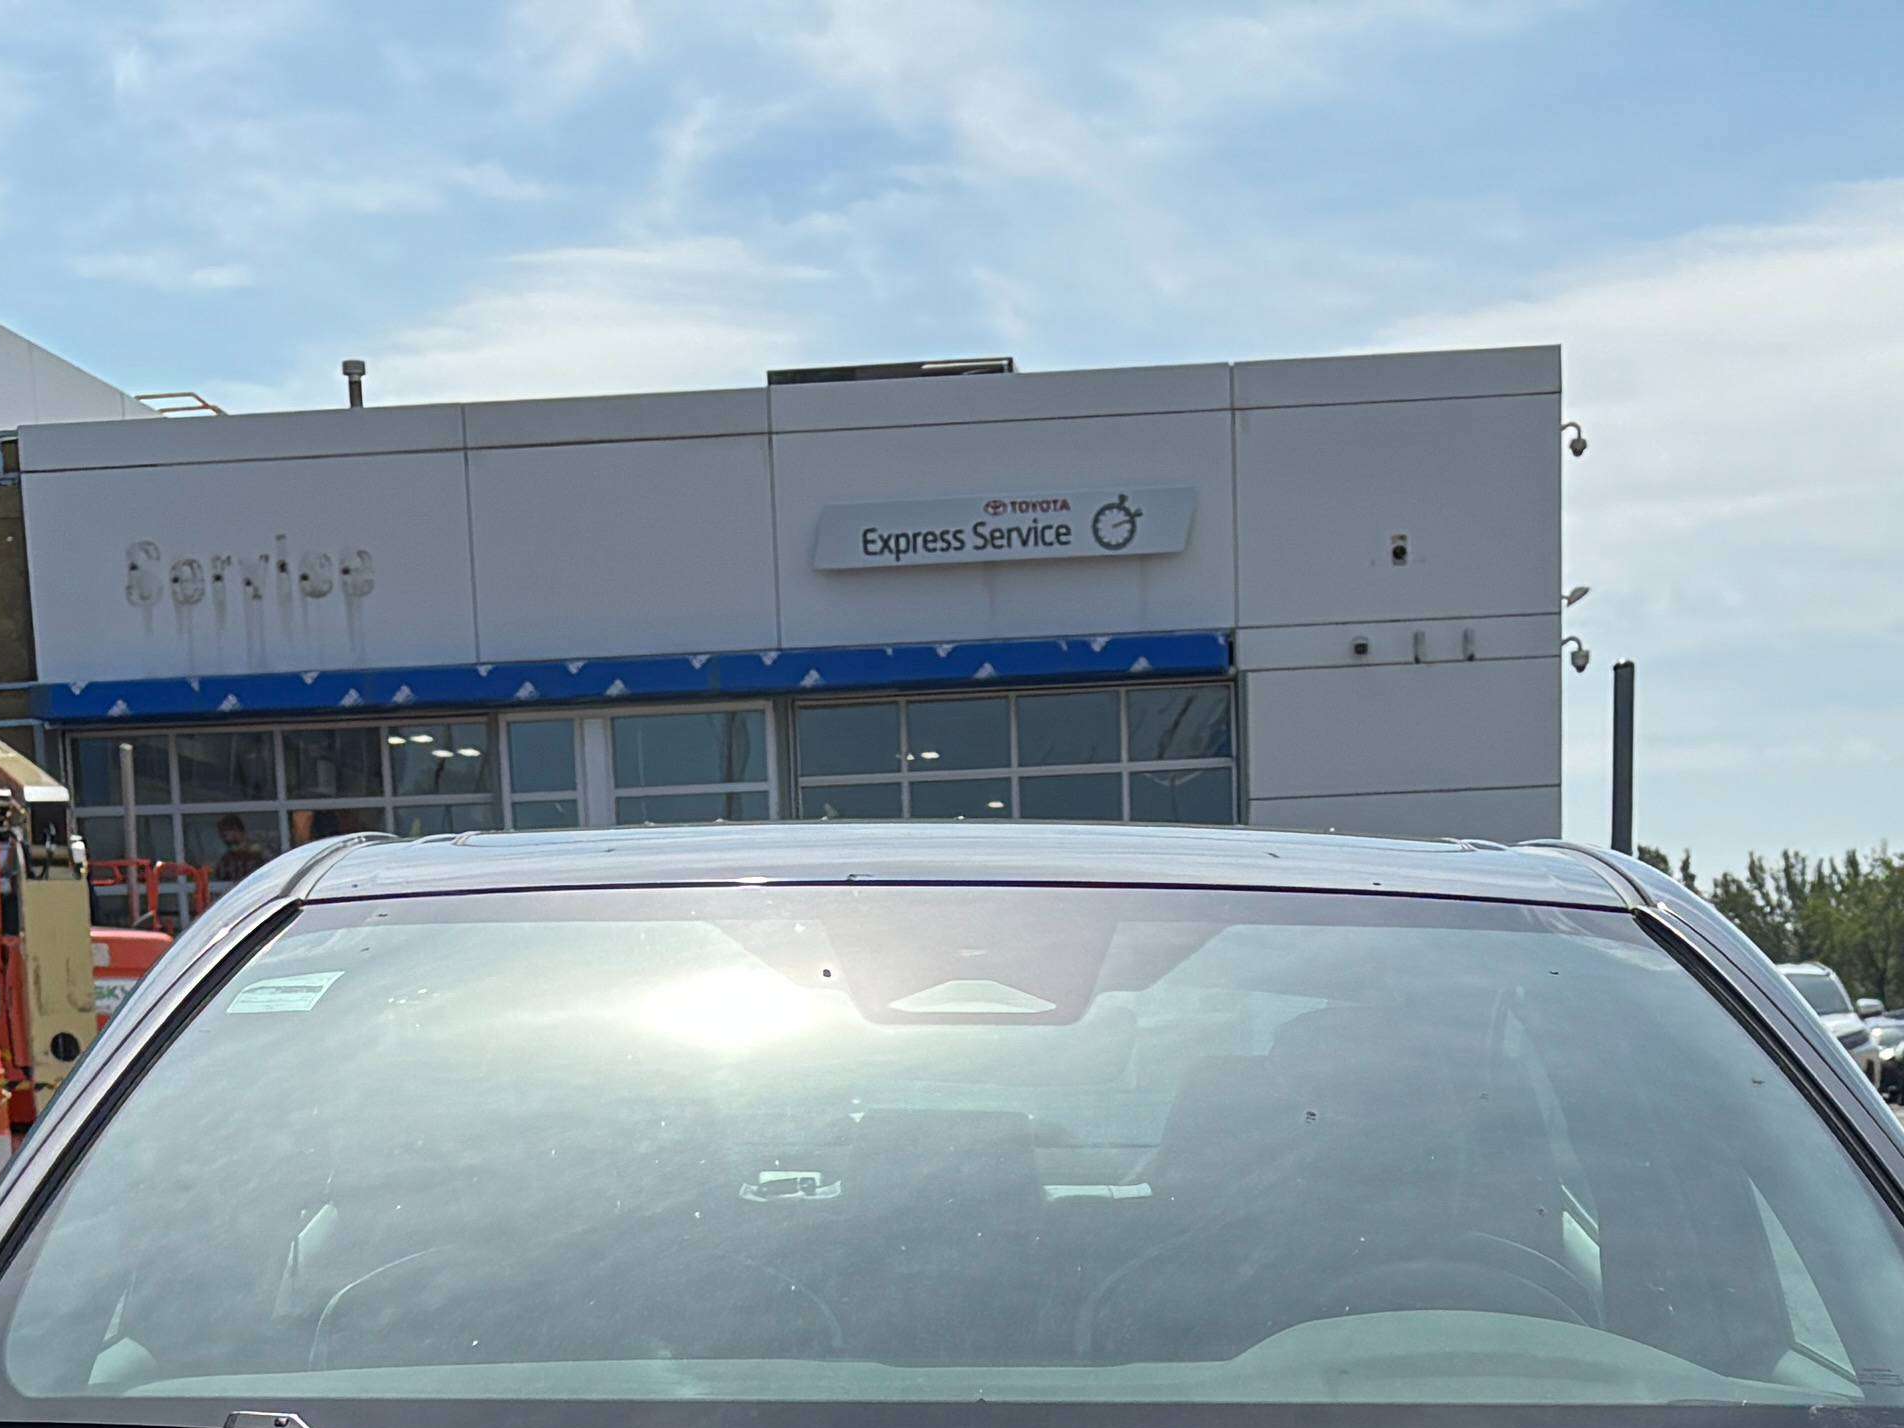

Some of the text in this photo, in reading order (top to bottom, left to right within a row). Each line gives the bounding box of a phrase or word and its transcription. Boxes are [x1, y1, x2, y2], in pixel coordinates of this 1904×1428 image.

[1010, 500, 1071, 513] TOYOTA
[863, 519, 1072, 562] Express Service
